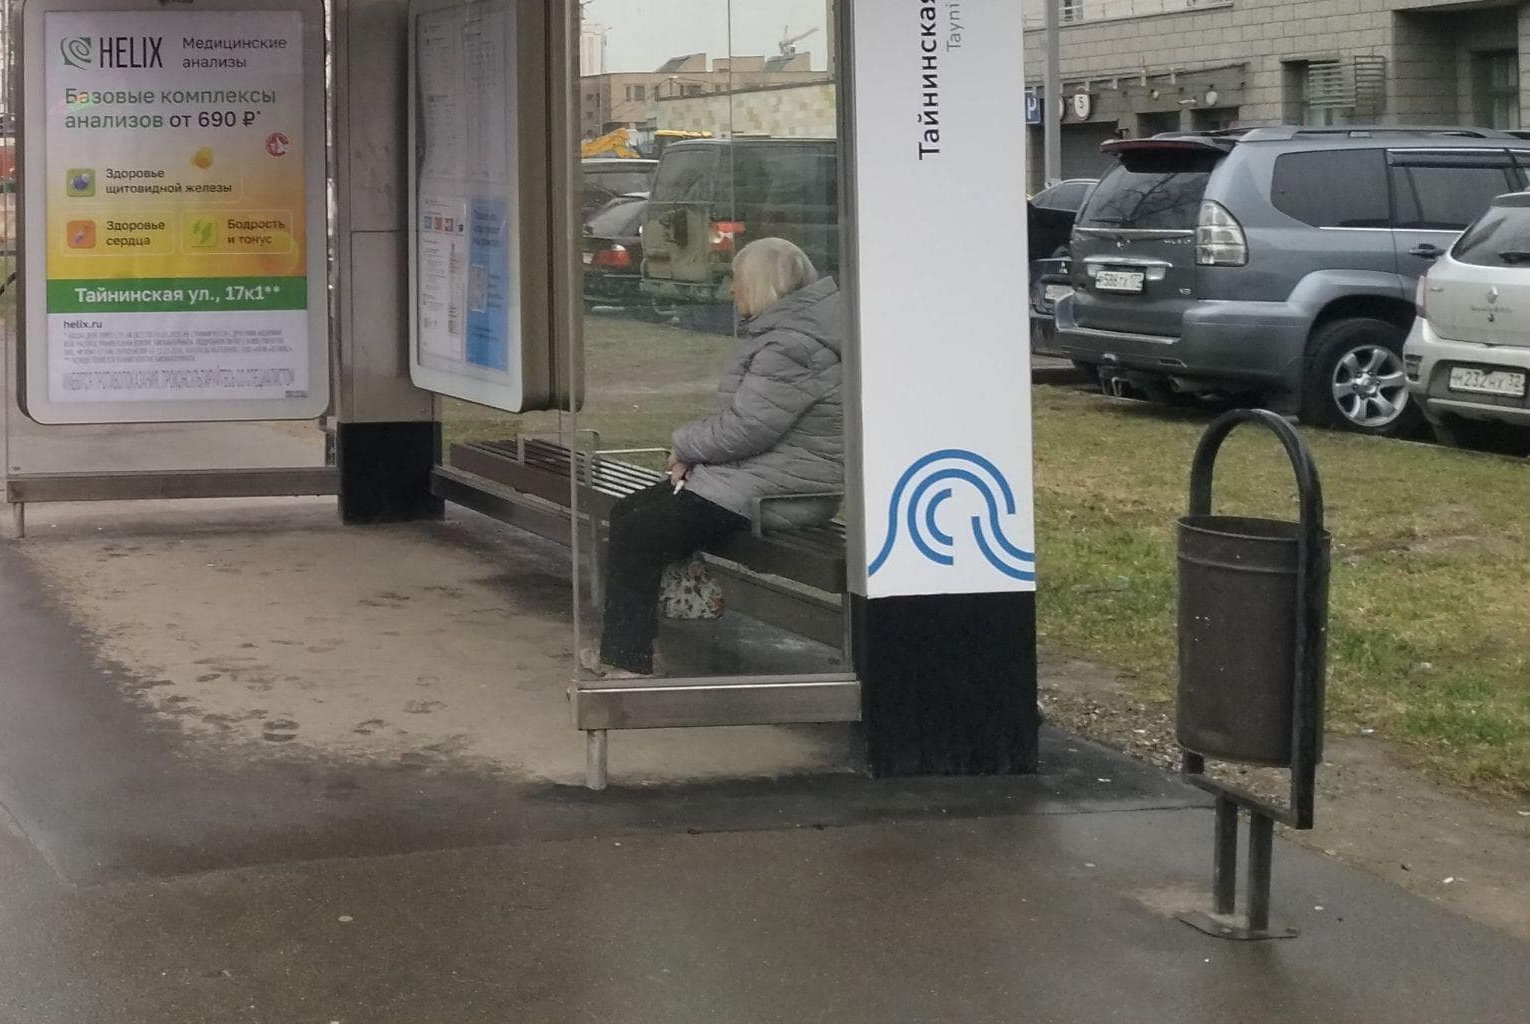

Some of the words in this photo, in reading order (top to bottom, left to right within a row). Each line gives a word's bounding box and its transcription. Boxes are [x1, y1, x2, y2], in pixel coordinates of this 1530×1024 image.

[182, 37, 288, 51] Медицинские
[99, 36, 164, 68] HELIX
[182, 57, 247, 69] анализы
[65, 88, 155, 105] Базовые
[161, 89, 276, 104] комплексы
[1026, 97, 1037, 120] P
[65, 113, 164, 128] анализов
[169, 114, 191, 127] от
[198, 111, 236, 127] 690
[106, 168, 165, 179] Здоровье
[106, 182, 182, 194] щитовидной
[185, 183, 232, 193] железы
[106, 220, 165, 232] Здоровье
[227, 218, 285, 231] Бодрость
[106, 235, 151, 247] сердца
[227, 236, 235, 245] и
[239, 234, 273, 246] тонус
[75, 287, 183, 304] Тайнинская
[188, 287, 220, 305] ул.,
[63, 319, 103, 329] helix.ru
